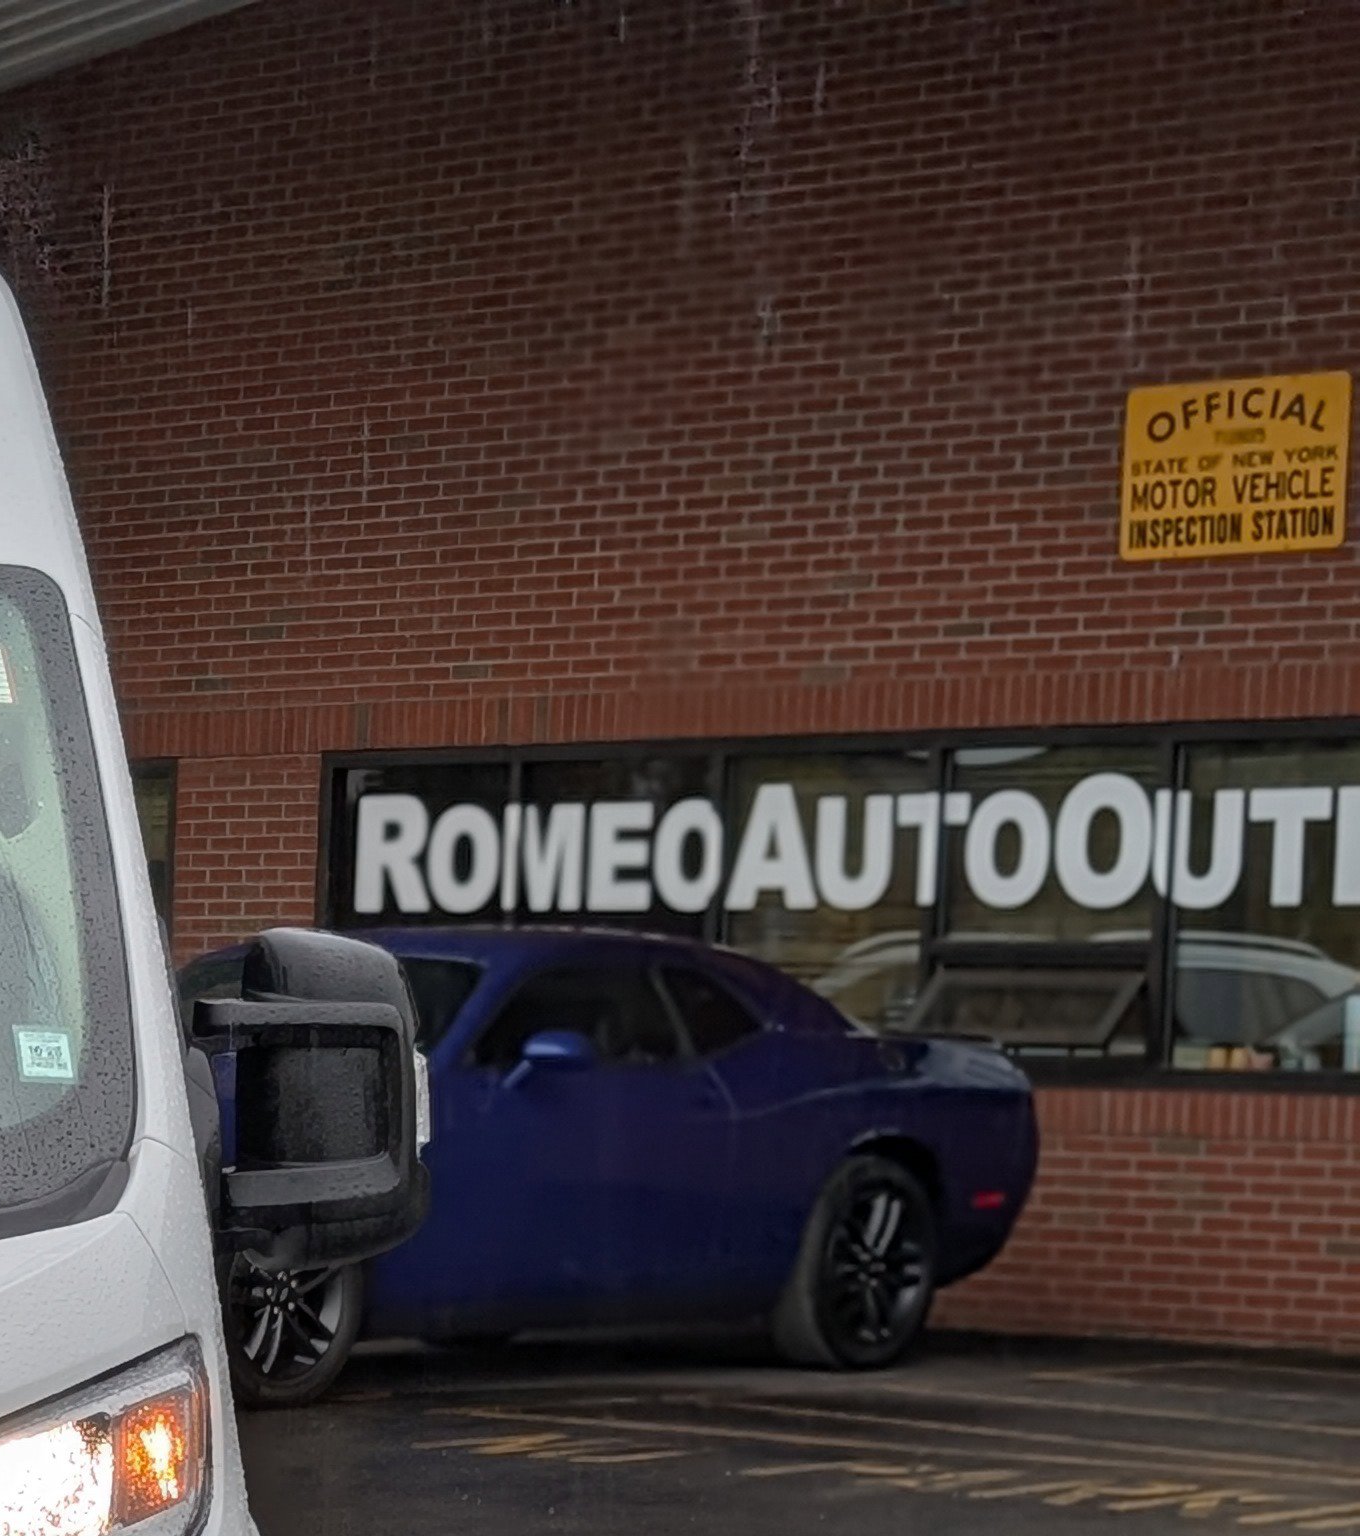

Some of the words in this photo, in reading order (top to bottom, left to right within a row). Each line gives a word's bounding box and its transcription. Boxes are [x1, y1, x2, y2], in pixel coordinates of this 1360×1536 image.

[1146, 387, 1326, 443] OFFICIAL
[1131, 456, 1189, 477] STATE
[1197, 453, 1223, 472] OF
[1232, 449, 1275, 468] NEW
[1284, 445, 1339, 464] YORK
[1130, 475, 1217, 512] MOTOR
[1232, 466, 1335, 504] VEHICLE
[1128, 512, 1243, 550] INSPECTION
[1251, 505, 1335, 542] STATION
